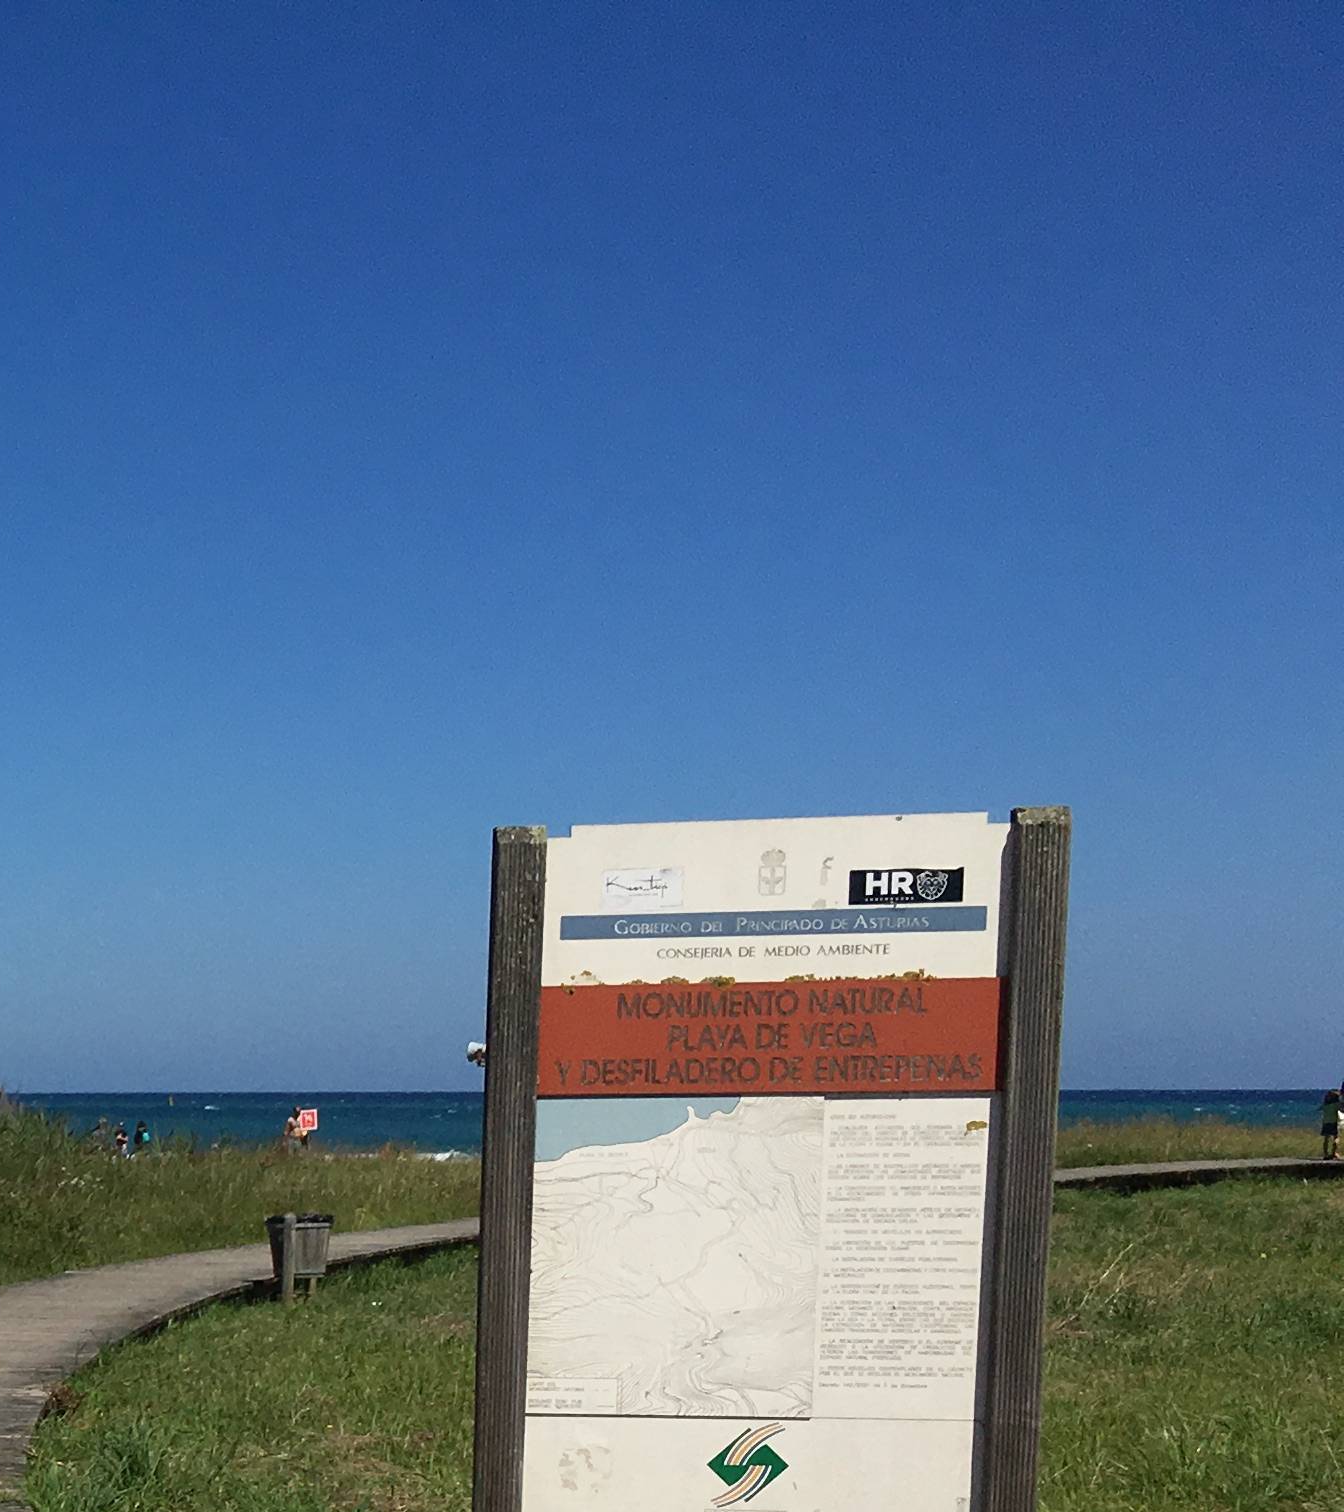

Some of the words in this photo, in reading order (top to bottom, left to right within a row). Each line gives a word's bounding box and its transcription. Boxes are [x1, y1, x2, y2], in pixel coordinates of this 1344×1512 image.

[865, 871, 913, 895] HR
[656, 947, 732, 959] CONSEJERIA
[738, 946, 755, 957] DE
[763, 945, 810, 956] MEDIO
[816, 943, 890, 955] AMBIENTE
[616, 990, 799, 1018] MONUMENTO
[807, 987, 928, 1014] NATURAL
[665, 1024, 747, 1052] PLAYA
[754, 1022, 790, 1050] DE
[799, 1022, 877, 1048] VEGA
[553, 1060, 570, 1086] Y
[579, 1057, 760, 1085] DESFILADERO
[768, 1056, 803, 1083] DE
